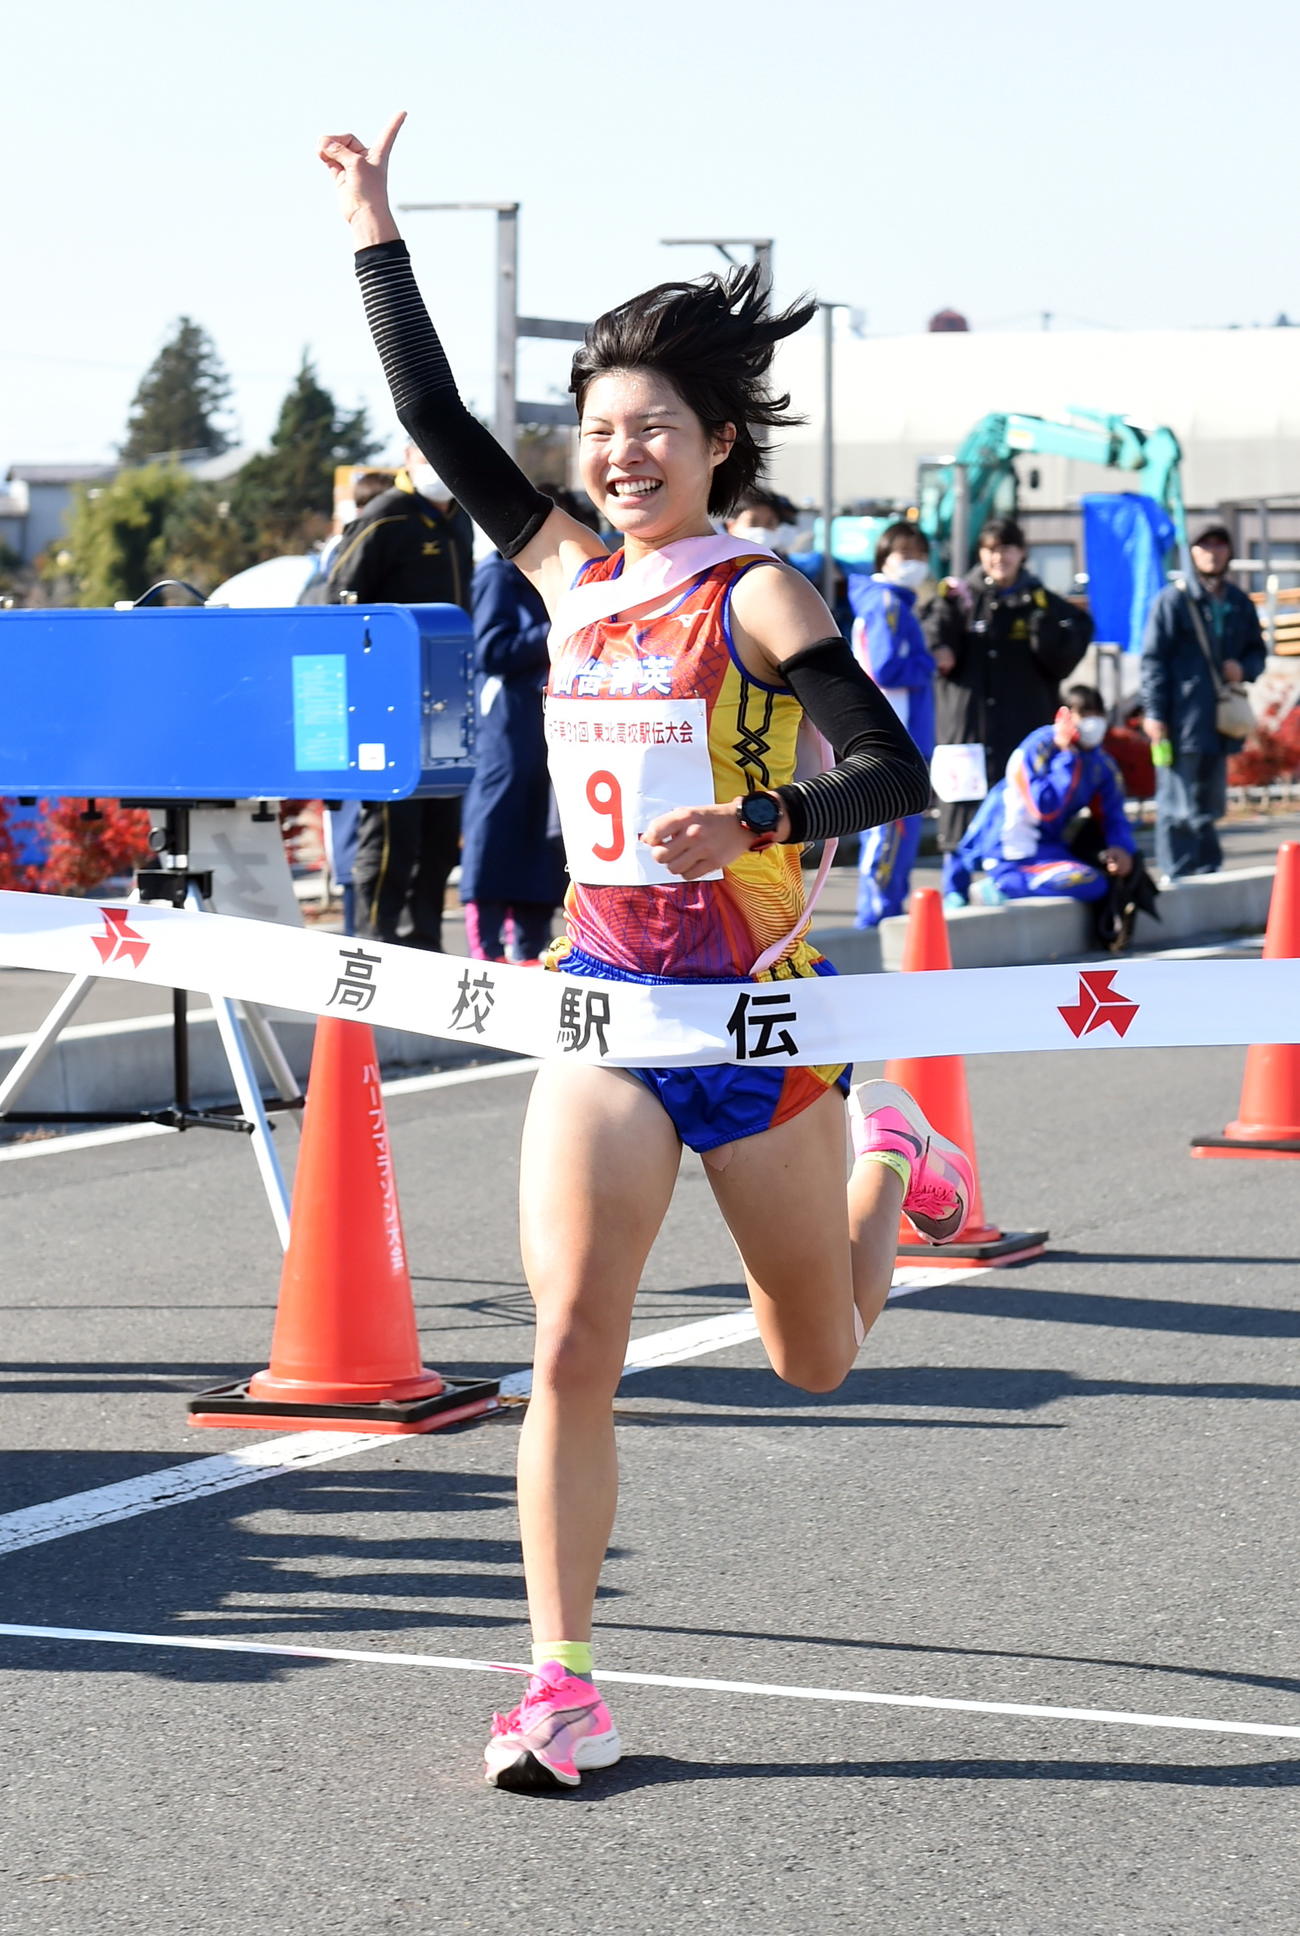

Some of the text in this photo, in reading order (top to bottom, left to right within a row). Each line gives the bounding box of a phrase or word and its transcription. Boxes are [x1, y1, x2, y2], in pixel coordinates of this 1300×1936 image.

[593, 721, 693, 744] 東北高校駅伝大会
[586, 769, 625, 862] 9
[327, 948, 800, 1059] 高校駅伝
